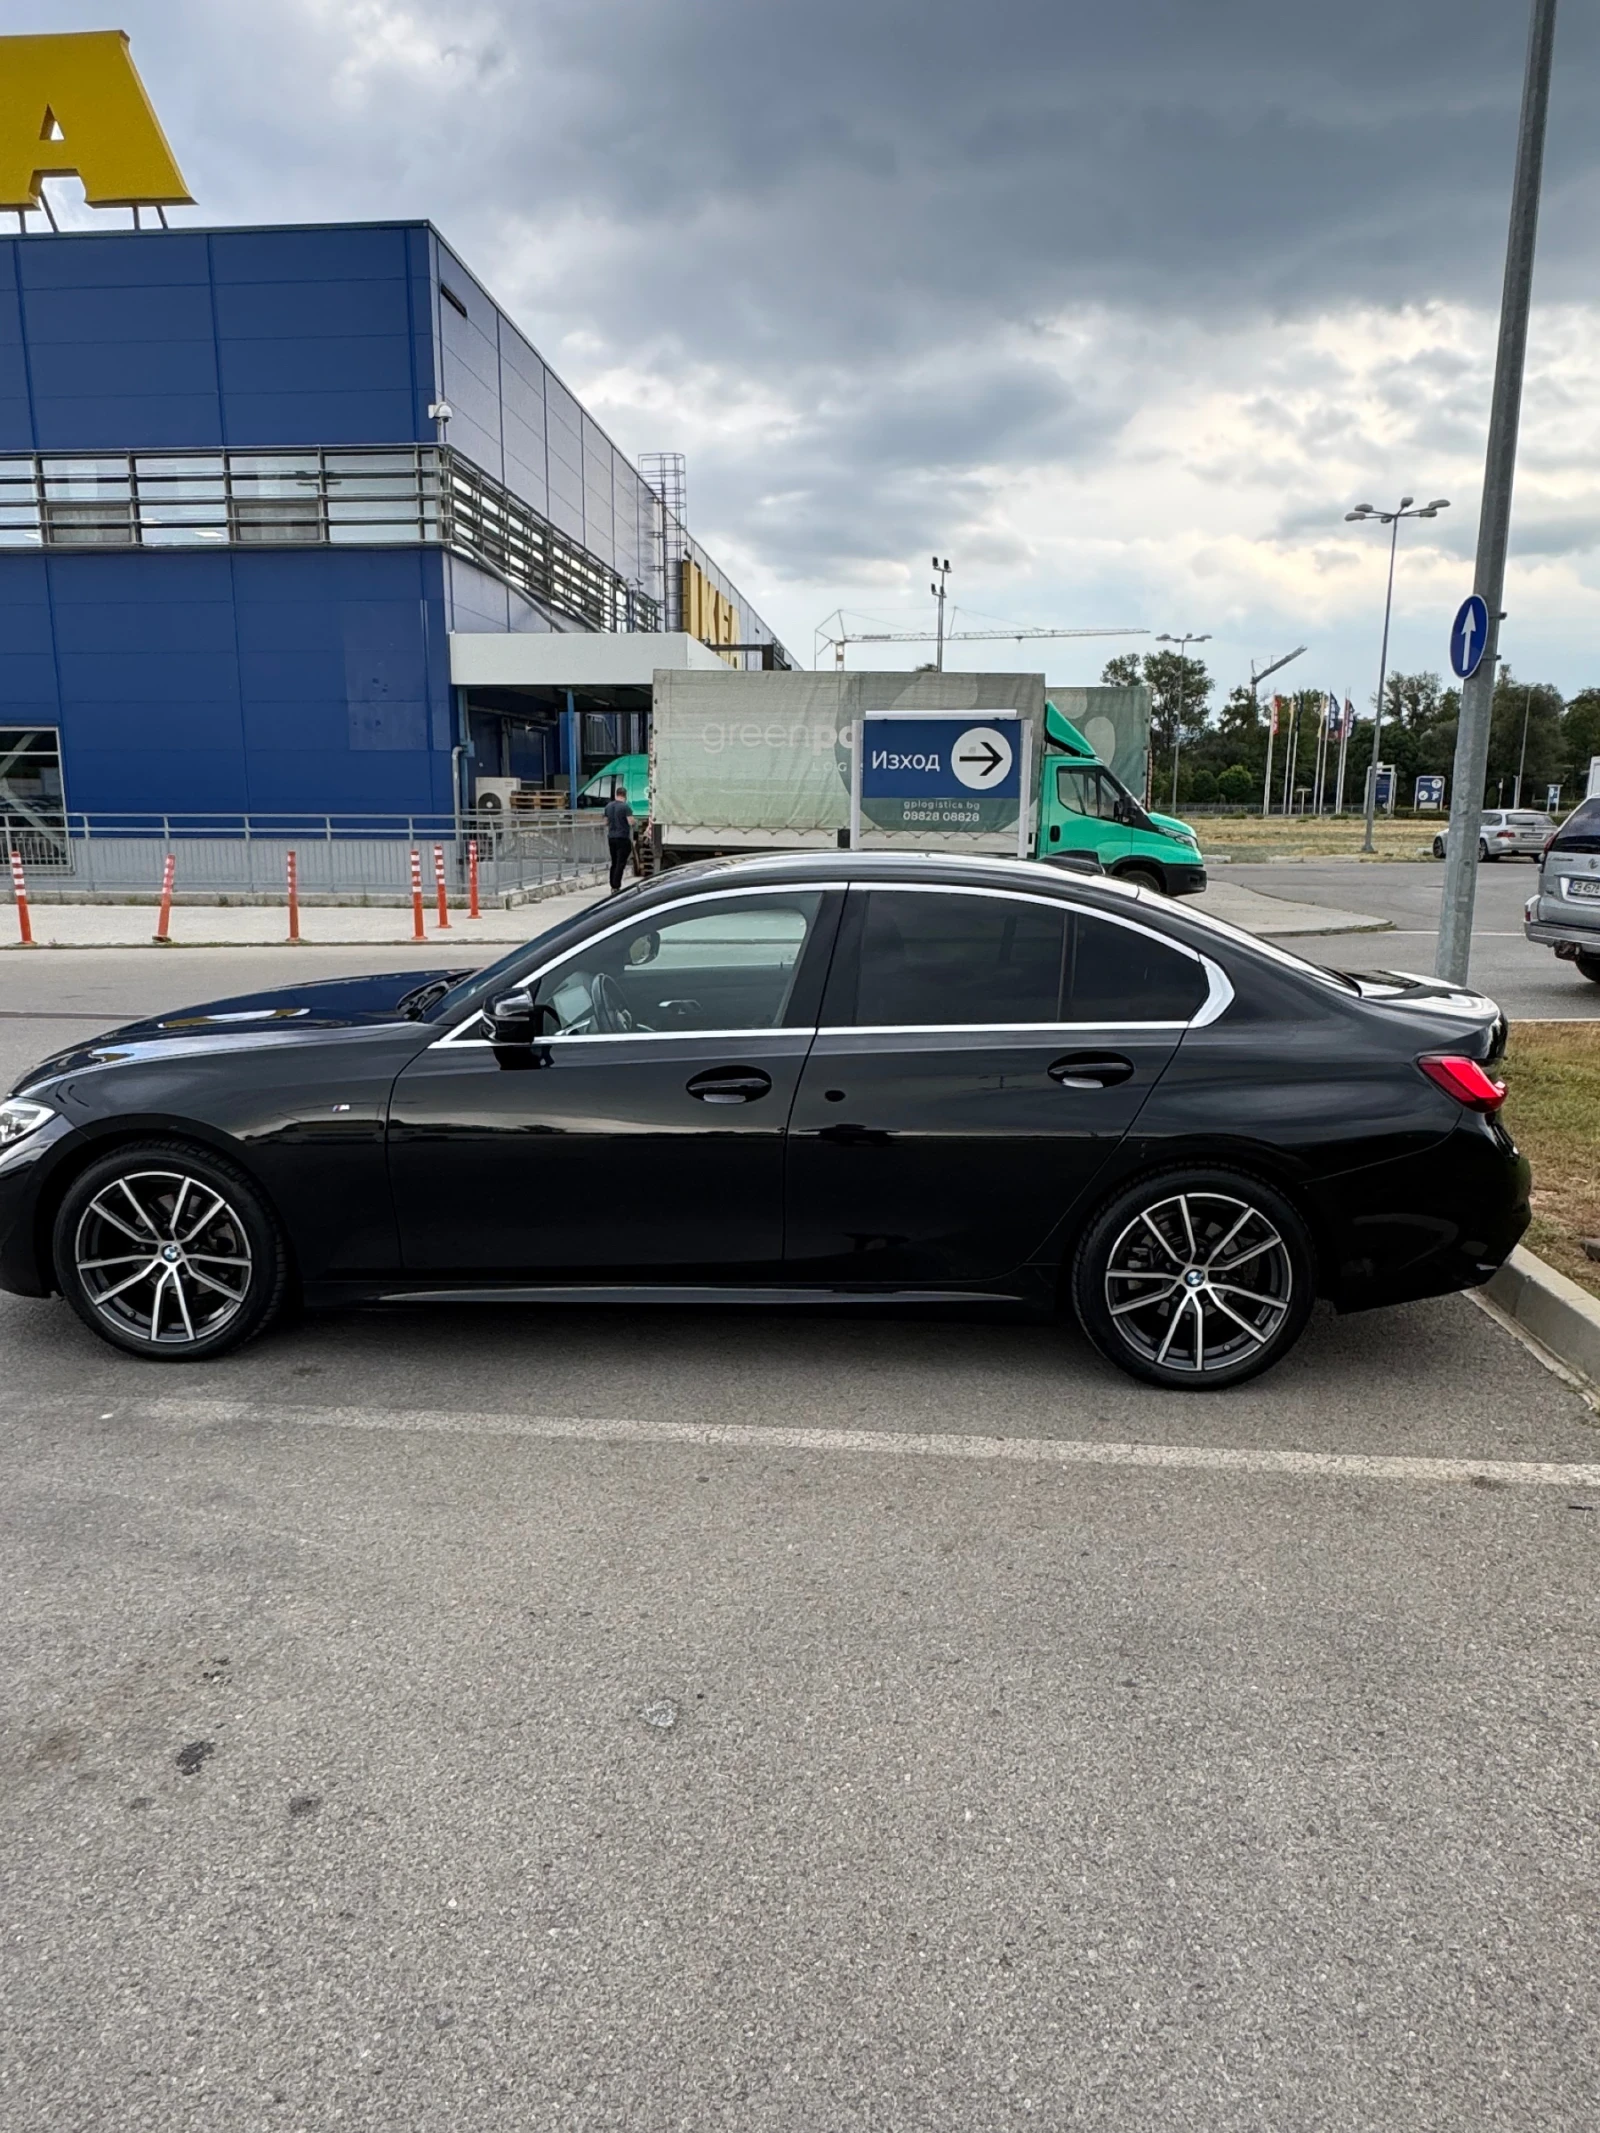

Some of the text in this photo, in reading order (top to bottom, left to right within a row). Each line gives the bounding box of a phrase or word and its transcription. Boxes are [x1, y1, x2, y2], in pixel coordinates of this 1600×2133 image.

[871, 750, 941, 772] Изход
[903, 800, 980, 811] gplogistics.bg
[902, 810, 980, 822] 08828 08828
